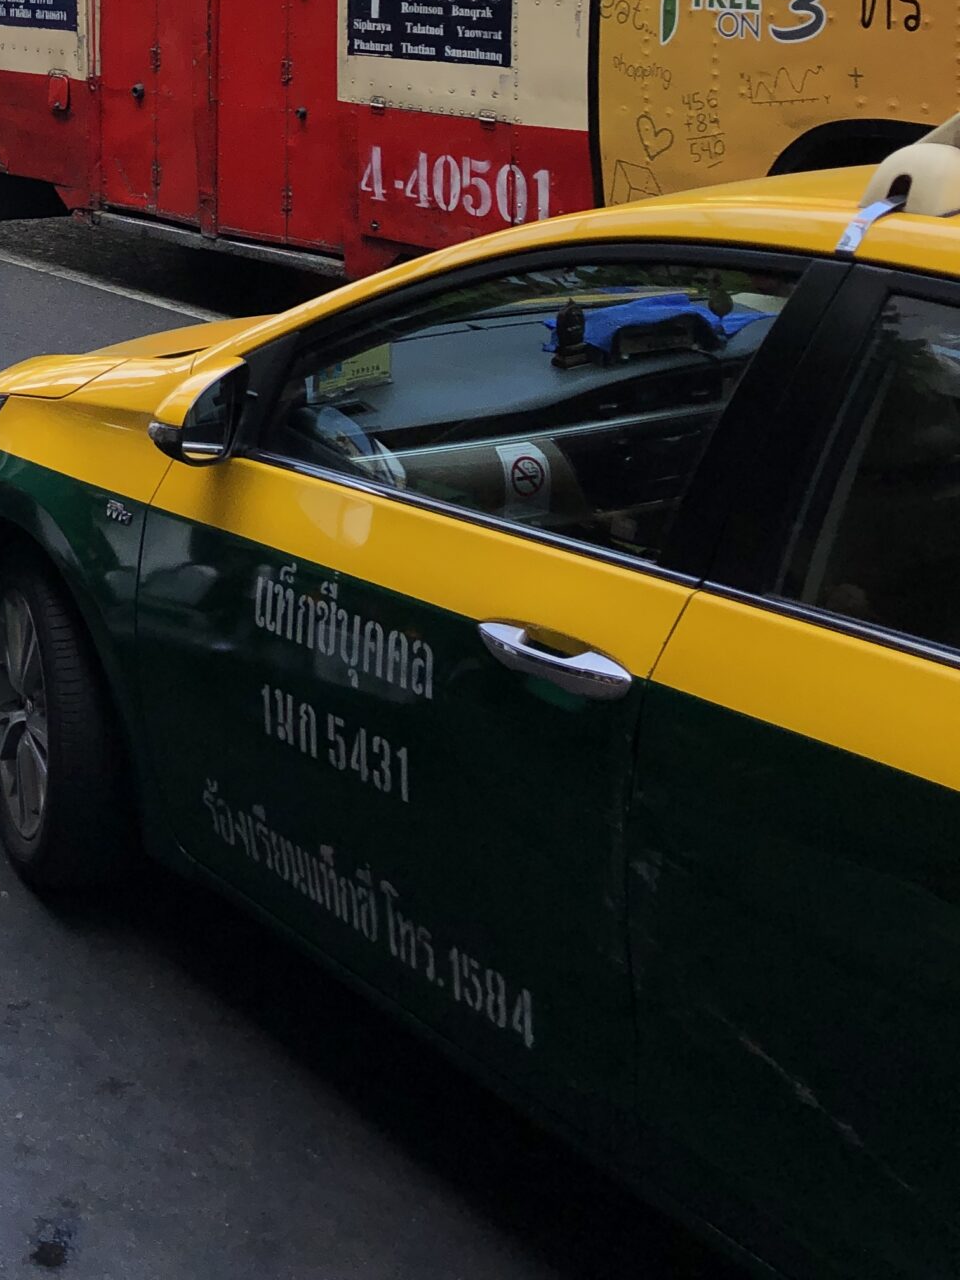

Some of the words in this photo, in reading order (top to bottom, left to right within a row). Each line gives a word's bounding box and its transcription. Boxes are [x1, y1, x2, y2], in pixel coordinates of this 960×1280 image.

[401, 2, 444, 15] Robinson
[353, 19, 391, 34] Siphraya
[405, 22, 444, 36] Talatnoi
[457, 25, 503, 40] Yaowarat
[715, 11, 761, 41] ON
[401, 42, 436, 55] Thatian
[360, 146, 551, 224] 4-40501
[254, 562, 435, 700] แท็กซี่บุคคล
[327, 713, 410, 803] 5431
